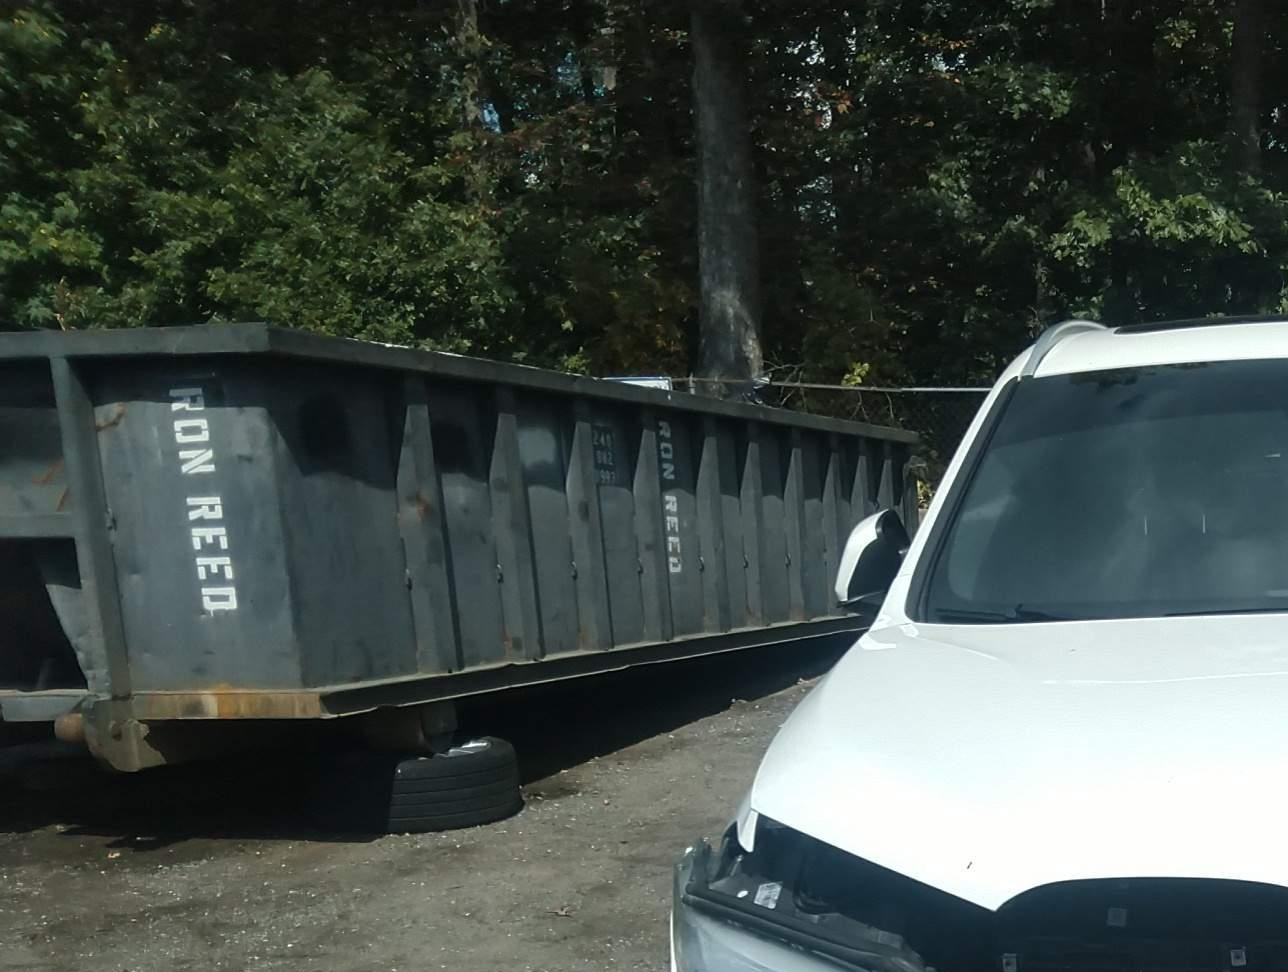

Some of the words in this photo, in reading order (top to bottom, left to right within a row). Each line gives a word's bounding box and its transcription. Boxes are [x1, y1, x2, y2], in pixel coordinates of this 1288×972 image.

[169, 388, 216, 475] RON
[658, 421, 675, 480] RON
[186, 496, 238, 617] REED
[664, 495, 682, 573] REED
